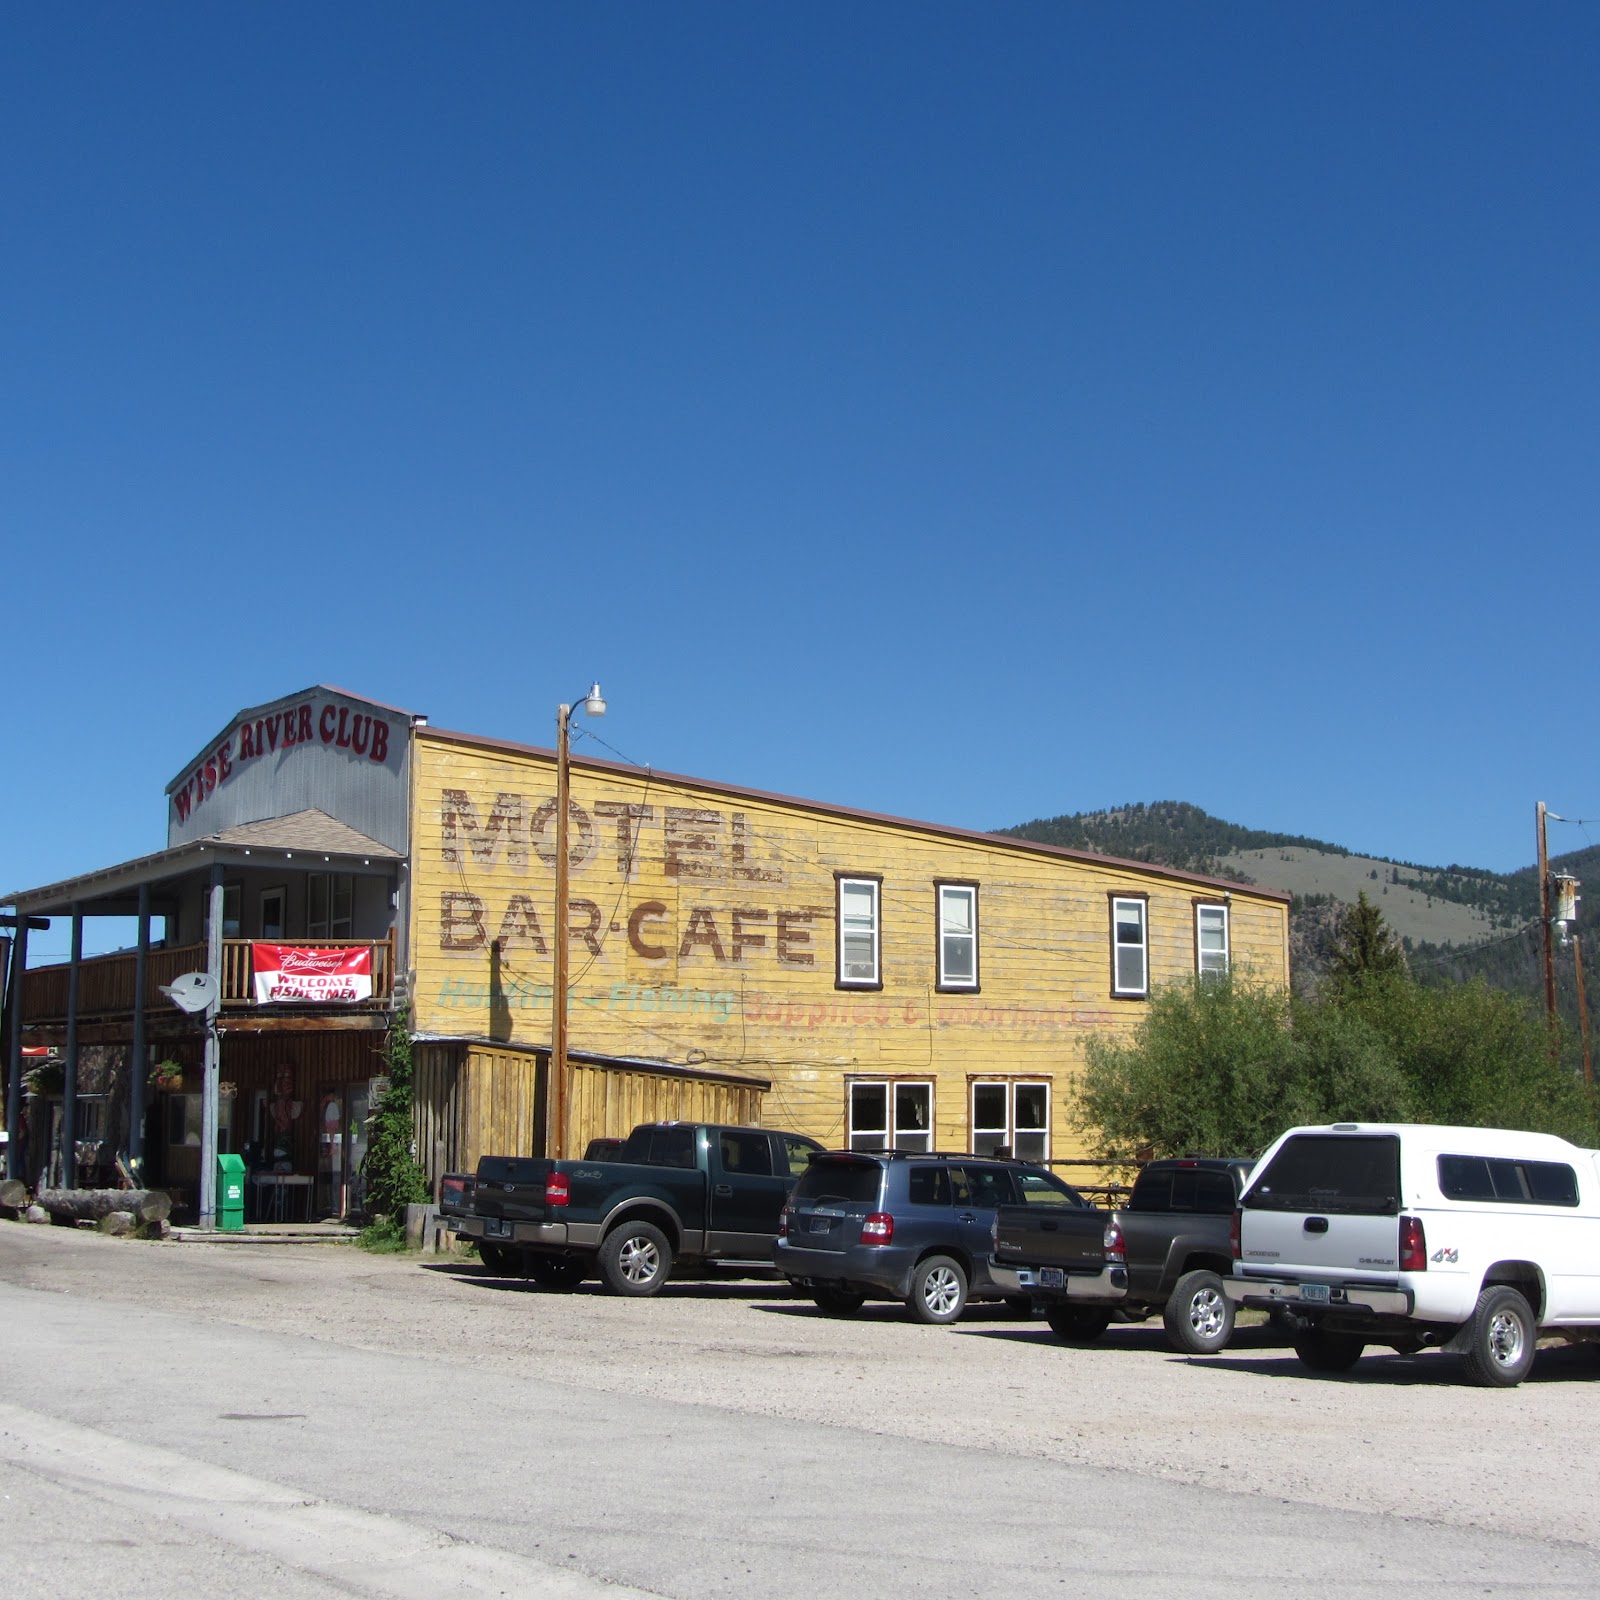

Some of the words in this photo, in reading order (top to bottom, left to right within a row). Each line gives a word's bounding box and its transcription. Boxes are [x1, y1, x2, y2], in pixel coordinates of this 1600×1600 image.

[174, 740, 232, 822] WISE
[240, 704, 313, 761] RIVER
[319, 704, 390, 763] CLUB
[442, 789, 783, 883] MOTEL
[279, 955, 343, 968] Budweiser
[278, 974, 354, 988] WELCOME
[269, 985, 358, 999] FISHERMEN
[608, 982, 734, 1024] Fishing
[745, 994, 891, 1032] Supplies
[1430, 1247, 1459, 1264] 4x4
